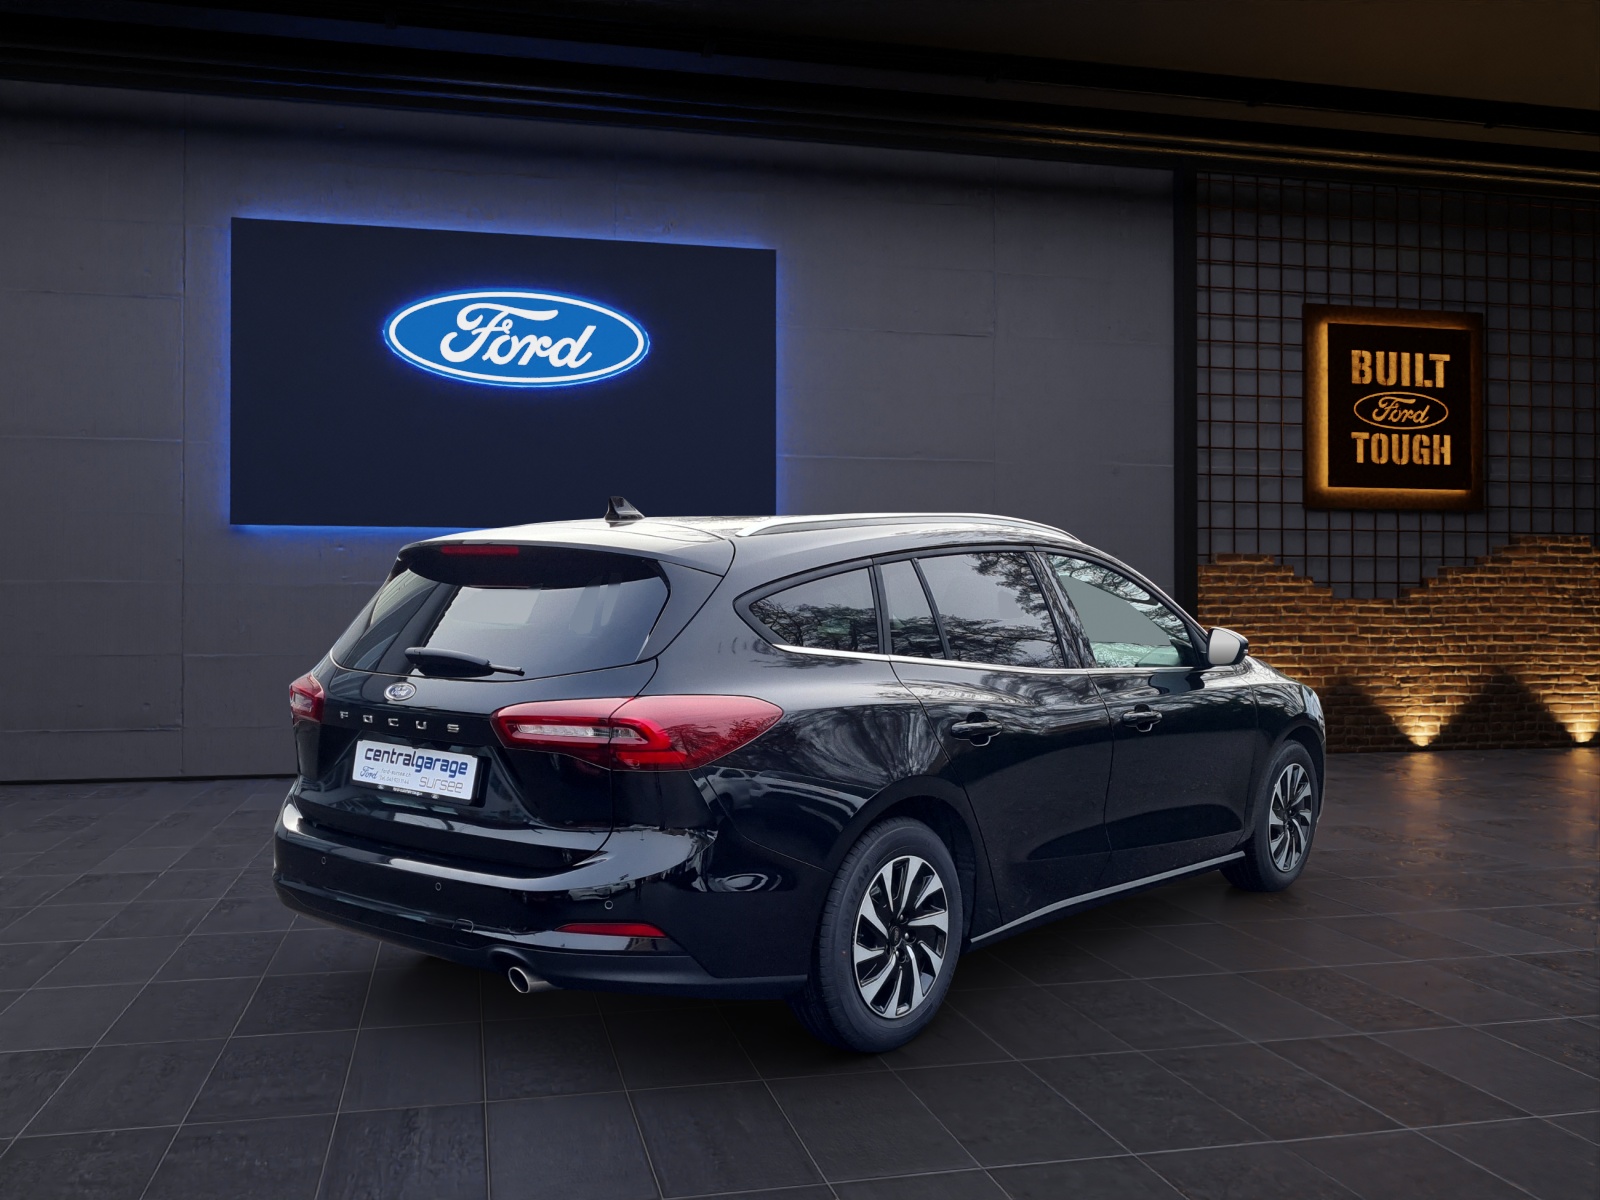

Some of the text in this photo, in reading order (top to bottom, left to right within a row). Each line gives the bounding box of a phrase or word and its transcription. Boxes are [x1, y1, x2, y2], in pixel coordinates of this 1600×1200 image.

[440, 303, 597, 369] Ford
[1351, 350, 1450, 388] BUILT
[1371, 396, 1431, 424] Ford
[1351, 432, 1452, 466] TOUGH
[340, 711, 460, 733] FOCUS
[360, 766, 378, 780] Ford
[364, 747, 469, 778] centralgarage
[419, 776, 464, 794] sursee
